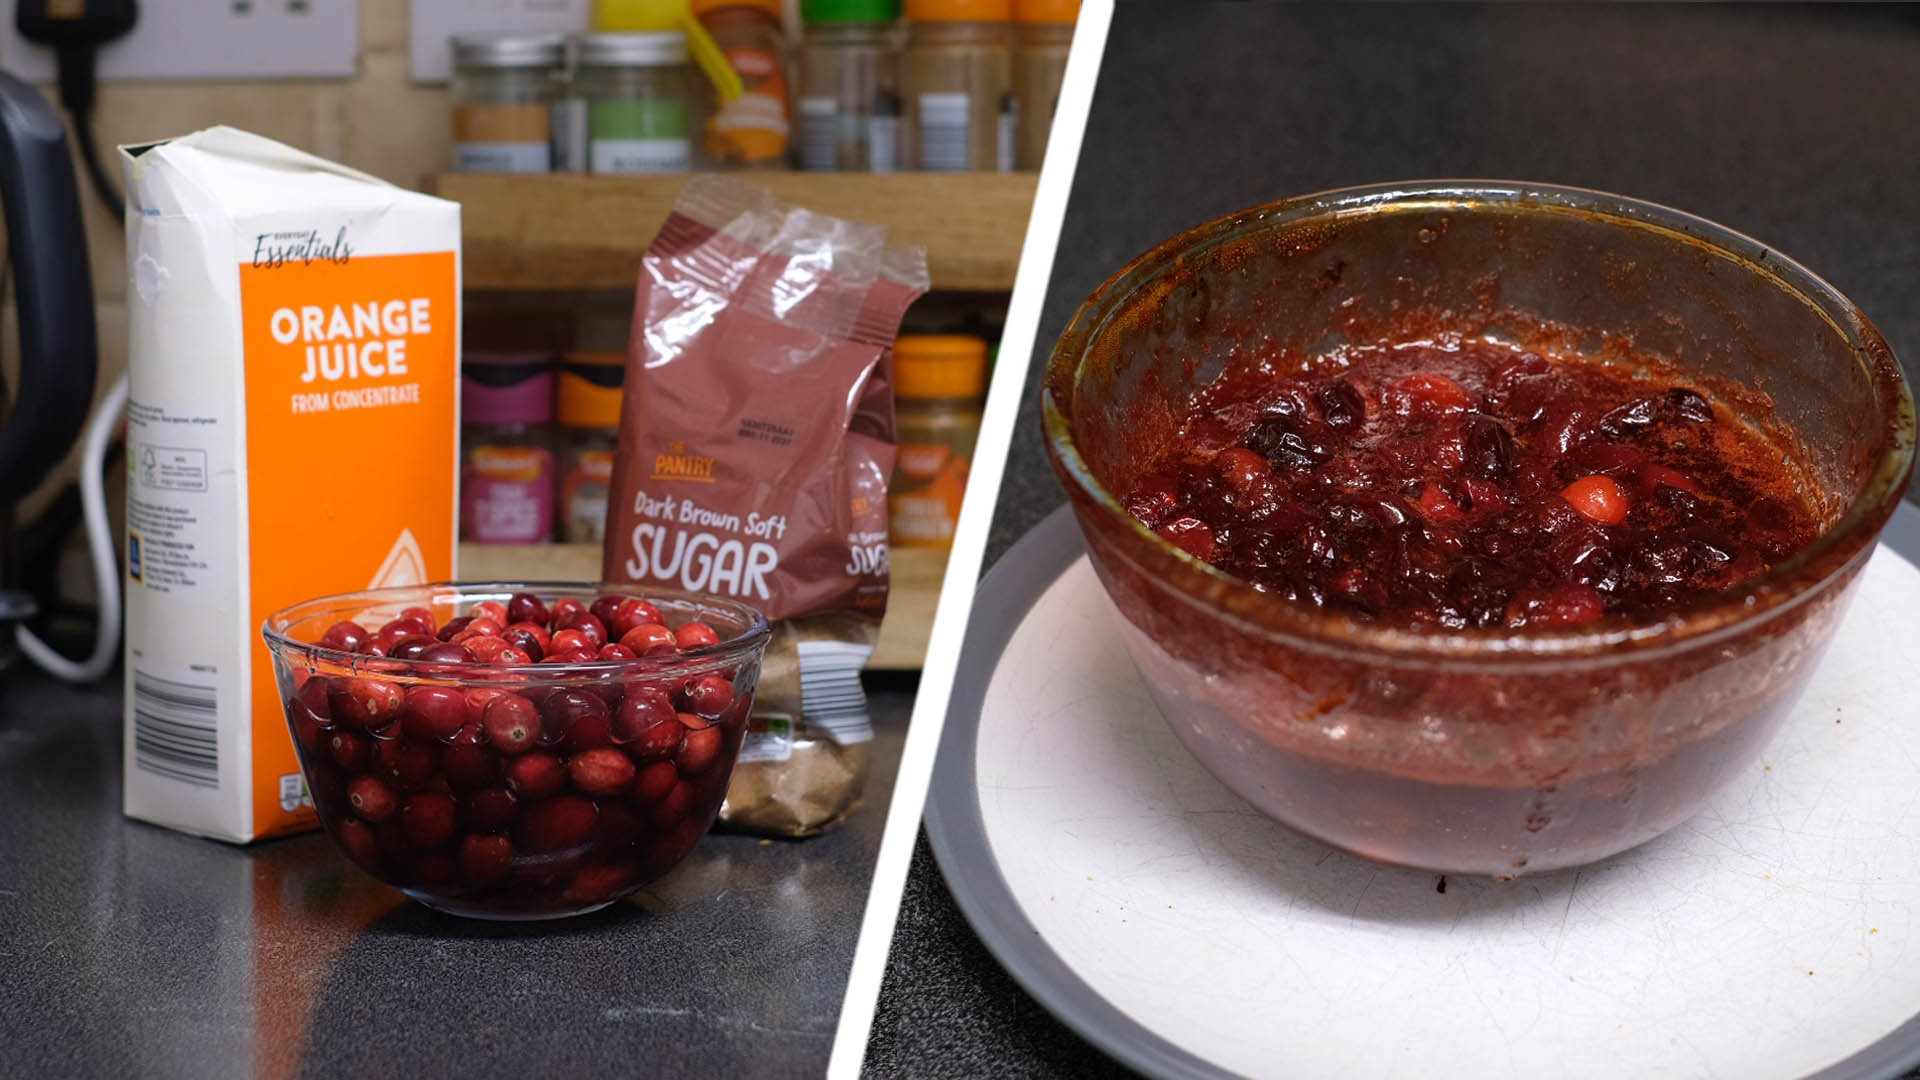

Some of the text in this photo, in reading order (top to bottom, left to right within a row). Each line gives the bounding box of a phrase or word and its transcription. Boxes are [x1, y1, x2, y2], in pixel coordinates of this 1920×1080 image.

[252, 225, 354, 269] Essentials
[270, 298, 432, 344] ORANGE
[301, 339, 408, 382] JUICE
[291, 383, 421, 413] FROM CONCENTRATE
[655, 455, 716, 478] PANTRY
[634, 491, 676, 520] Dark
[680, 499, 740, 533] Brown
[744, 511, 787, 540] Soft
[625, 522, 779, 600] SUGAR
